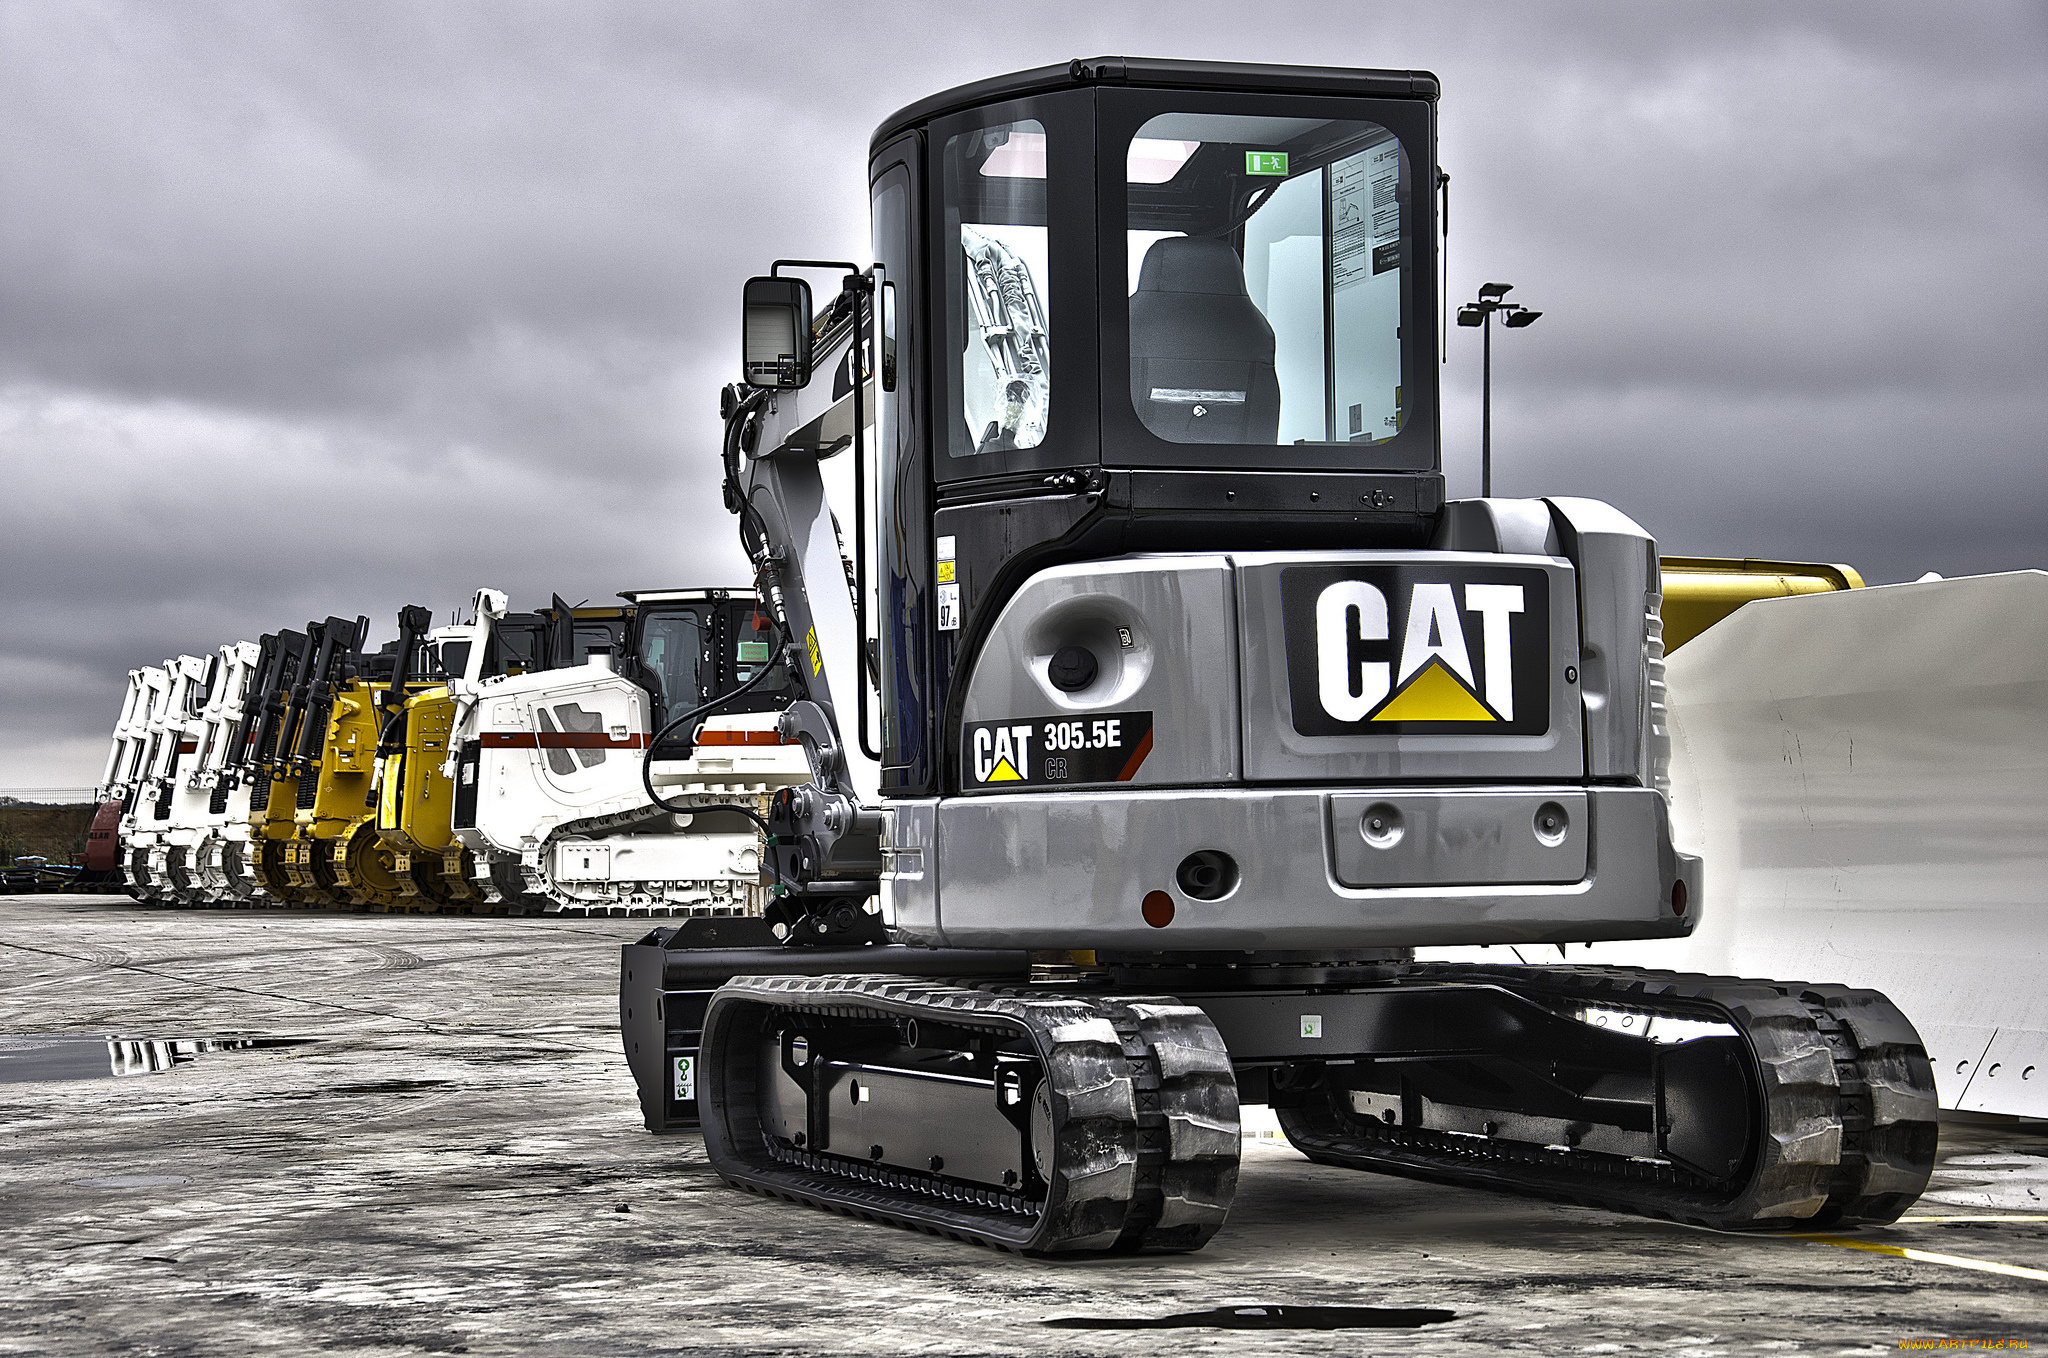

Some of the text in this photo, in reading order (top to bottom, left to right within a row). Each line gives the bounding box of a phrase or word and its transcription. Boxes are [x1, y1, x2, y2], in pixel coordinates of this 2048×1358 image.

[941, 605, 951, 627] 97
[1315, 580, 1525, 722] CAT
[1044, 719, 1121, 751] 305.5E
[973, 725, 1033, 782] CAT
[1045, 757, 1068, 780] CR
